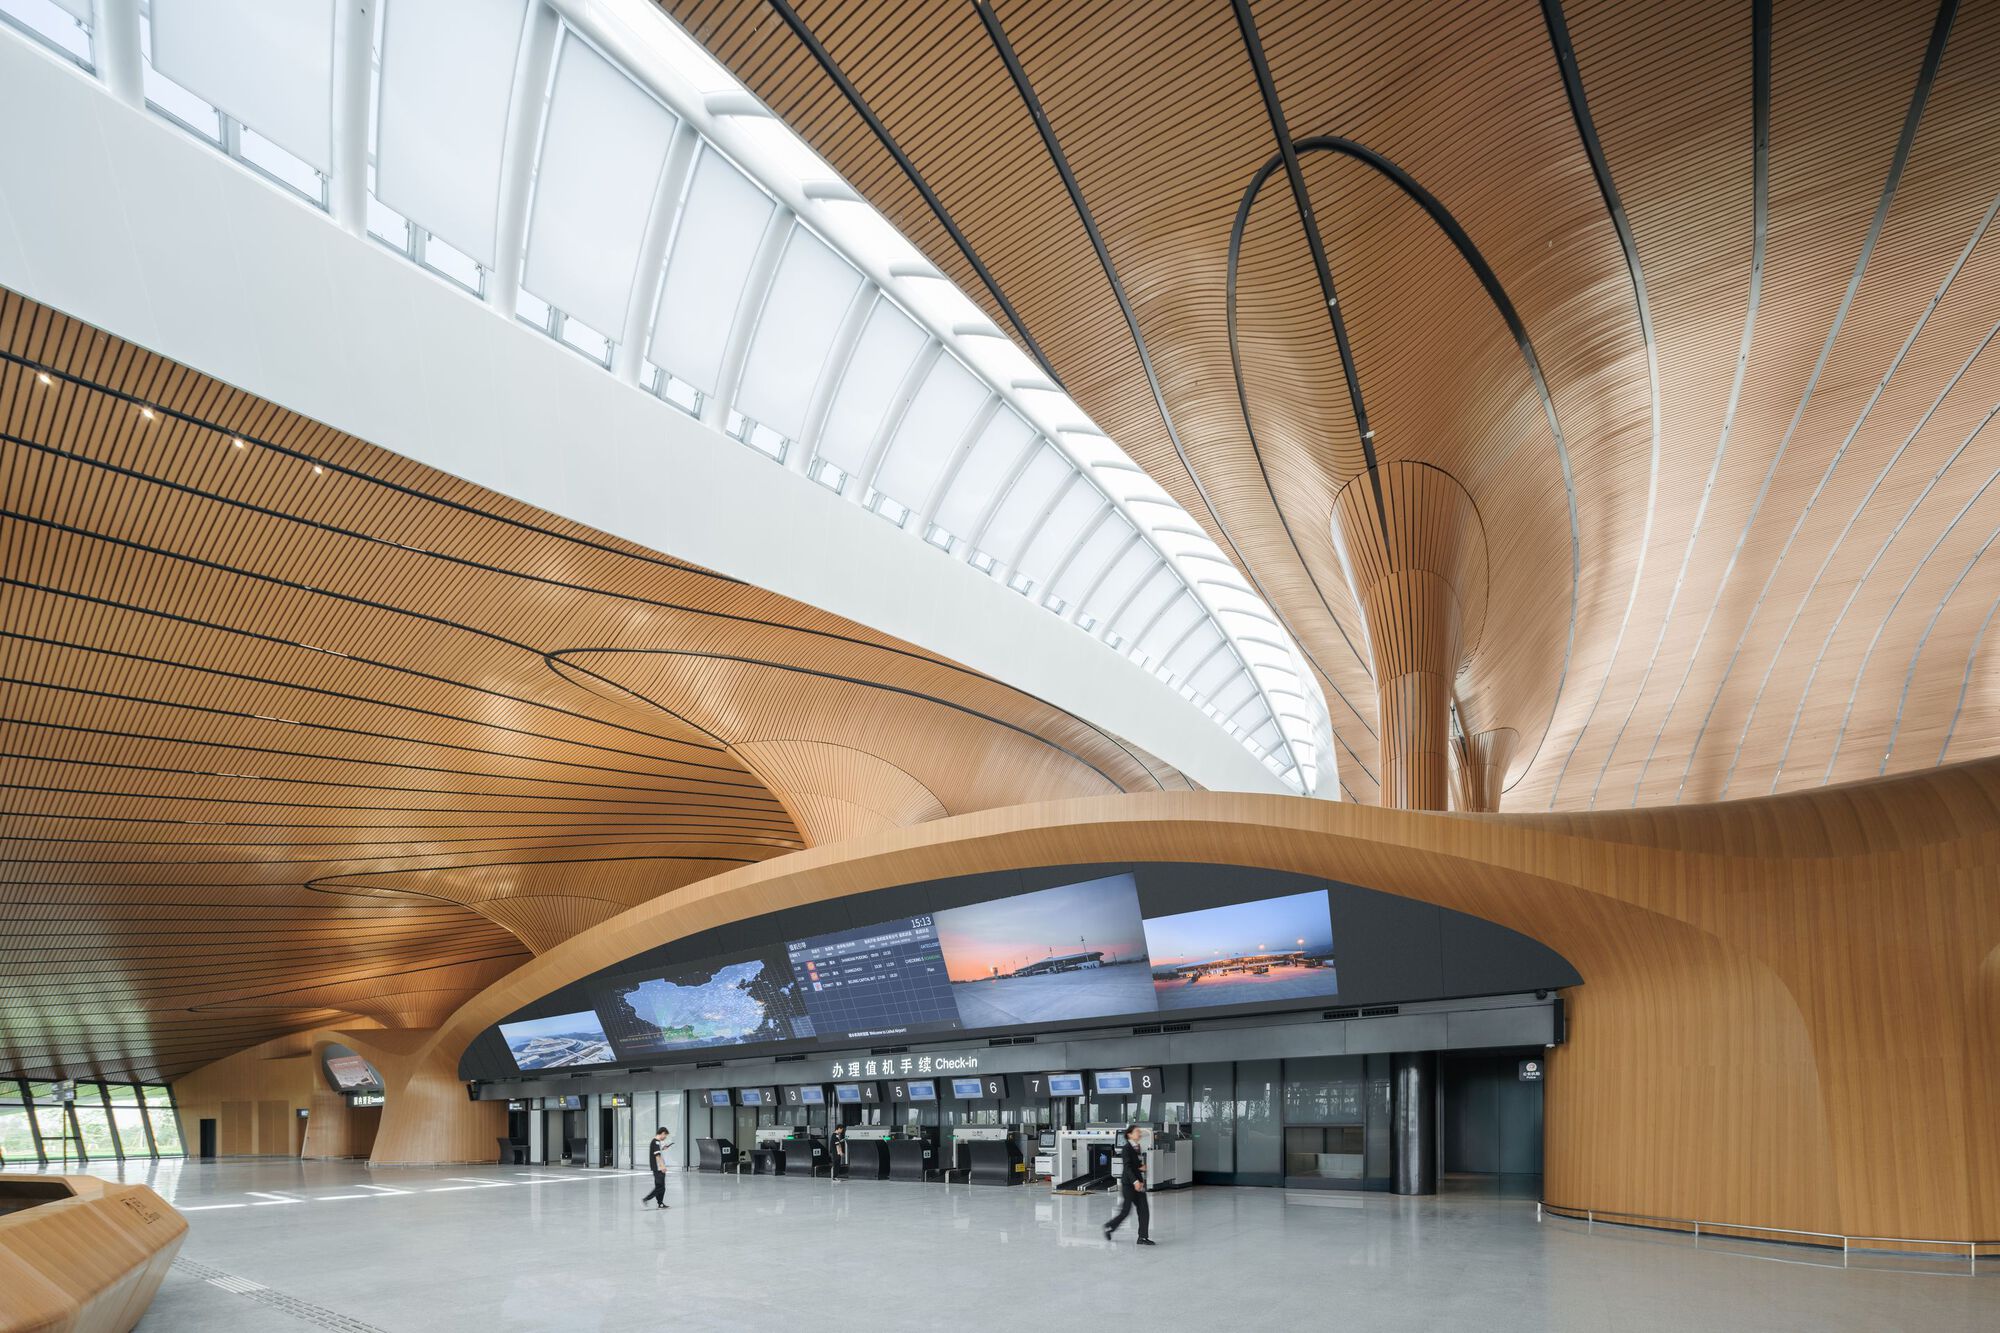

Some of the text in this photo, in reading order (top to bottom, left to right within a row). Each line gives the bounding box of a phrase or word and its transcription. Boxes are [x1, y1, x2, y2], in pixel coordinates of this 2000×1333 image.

[912, 916, 932, 929] 15:13
[832, 1056, 932, 1078] 办理值机手续
[935, 1056, 978, 1070] Check-in
[989, 1081, 998, 1094] 6
[1032, 1080, 1040, 1093] 7
[1142, 1075, 1152, 1089] 8
[765, 1091, 772, 1103] 2
[790, 1091, 797, 1101] 3
[865, 1087, 873, 1099] 4
[895, 1086, 903, 1098] 5
[703, 1094, 708, 1104] 1
